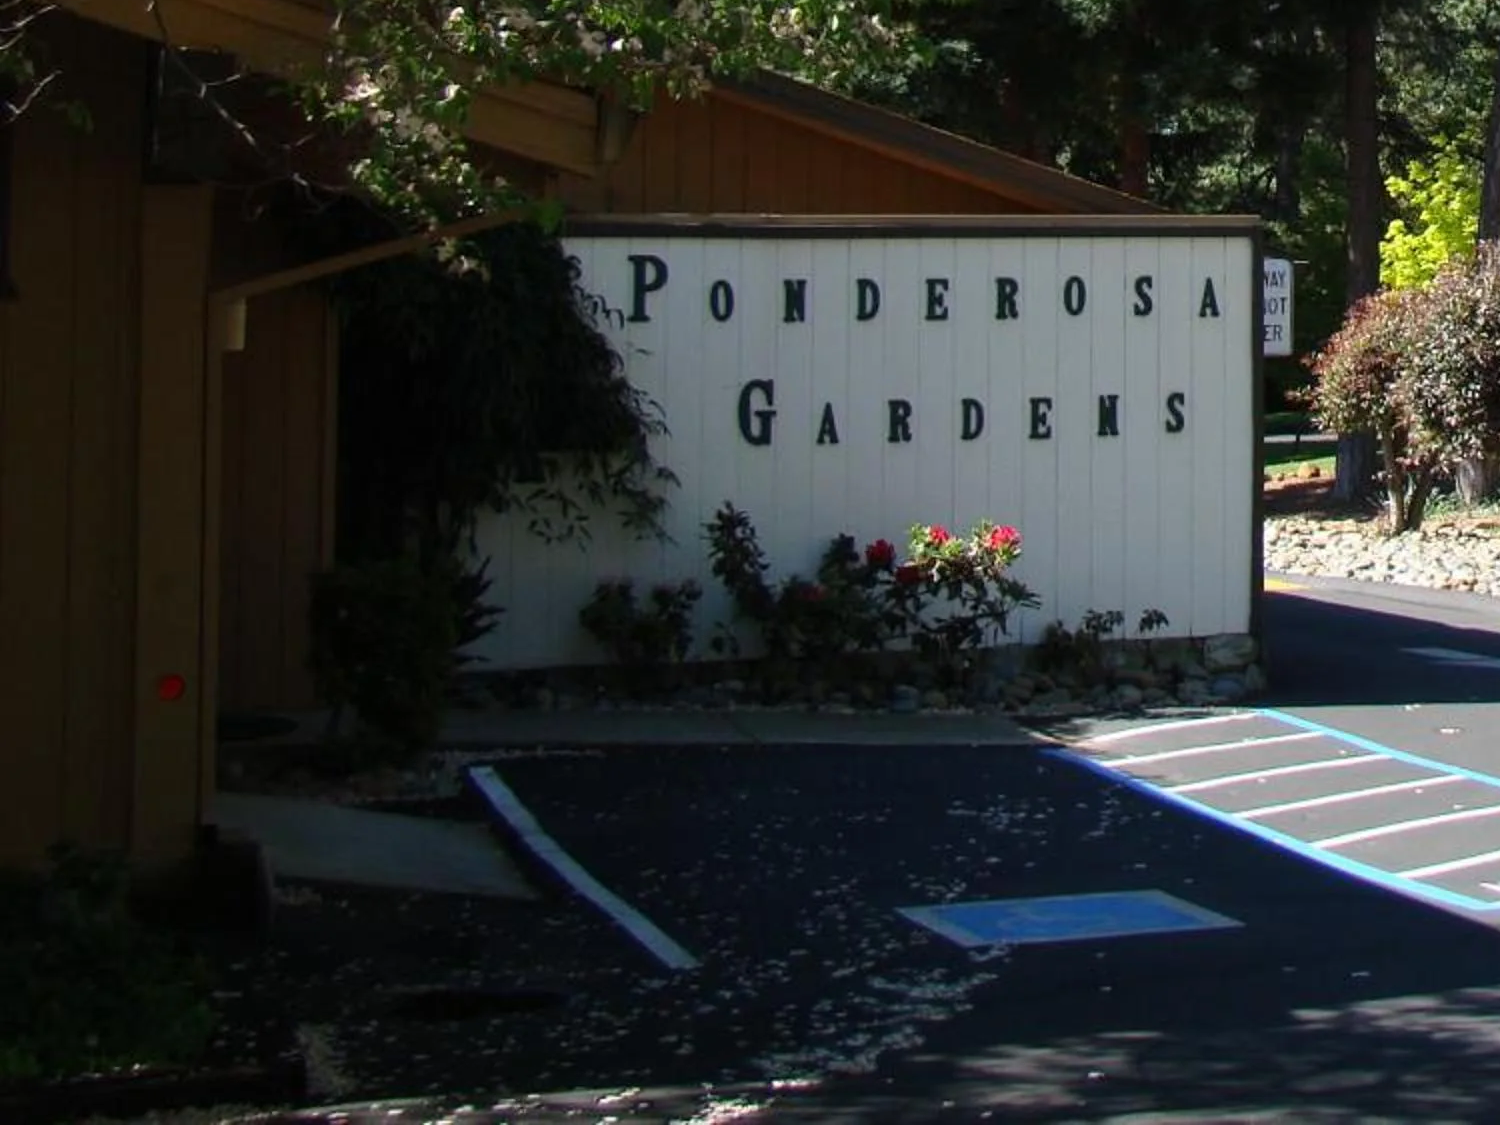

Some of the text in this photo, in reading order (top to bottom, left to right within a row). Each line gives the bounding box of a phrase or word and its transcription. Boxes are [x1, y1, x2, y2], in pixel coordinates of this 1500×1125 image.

[626, 254, 1220, 323] PONDEROSA
[1263, 297, 1287, 315] OT
[737, 378, 1187, 446] GARDENS
